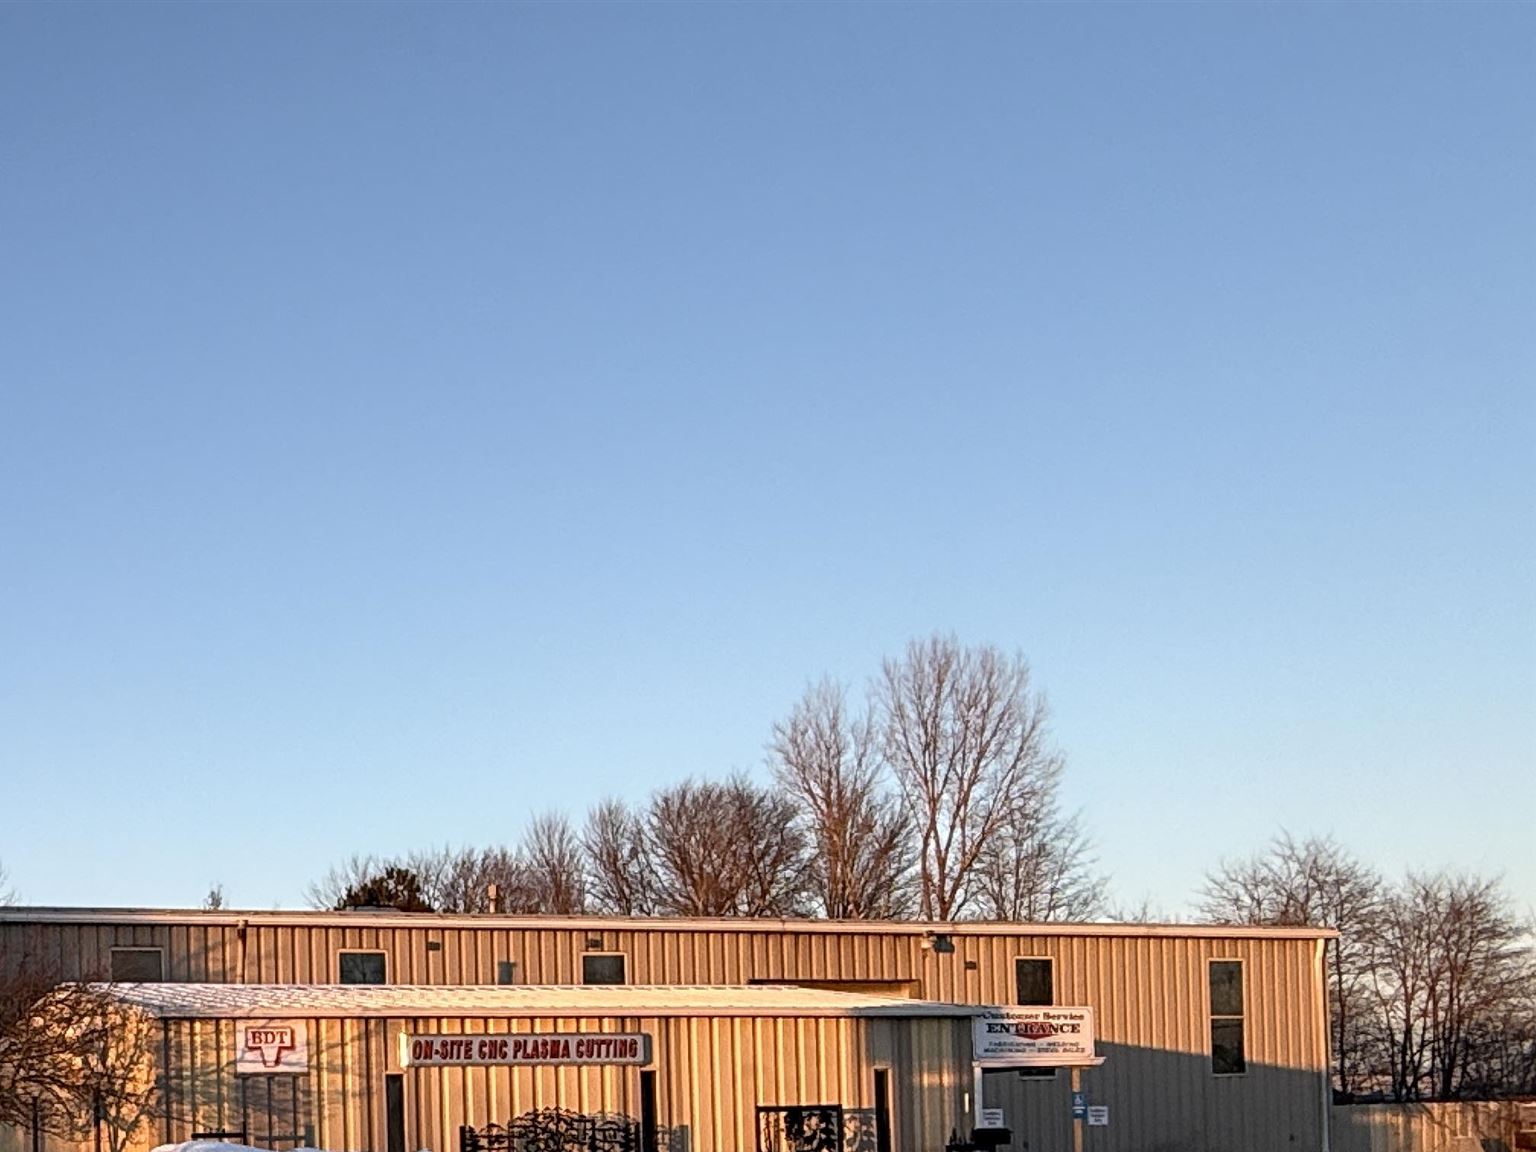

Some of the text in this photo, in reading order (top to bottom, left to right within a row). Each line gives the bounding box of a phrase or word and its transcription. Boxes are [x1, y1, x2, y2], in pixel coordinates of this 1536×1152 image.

[986, 1023, 1080, 1033] ENTRANCE
[250, 1031, 287, 1044] BDT
[413, 1038, 639, 1060] ON-SITE CNC PLASMA CUTTING
